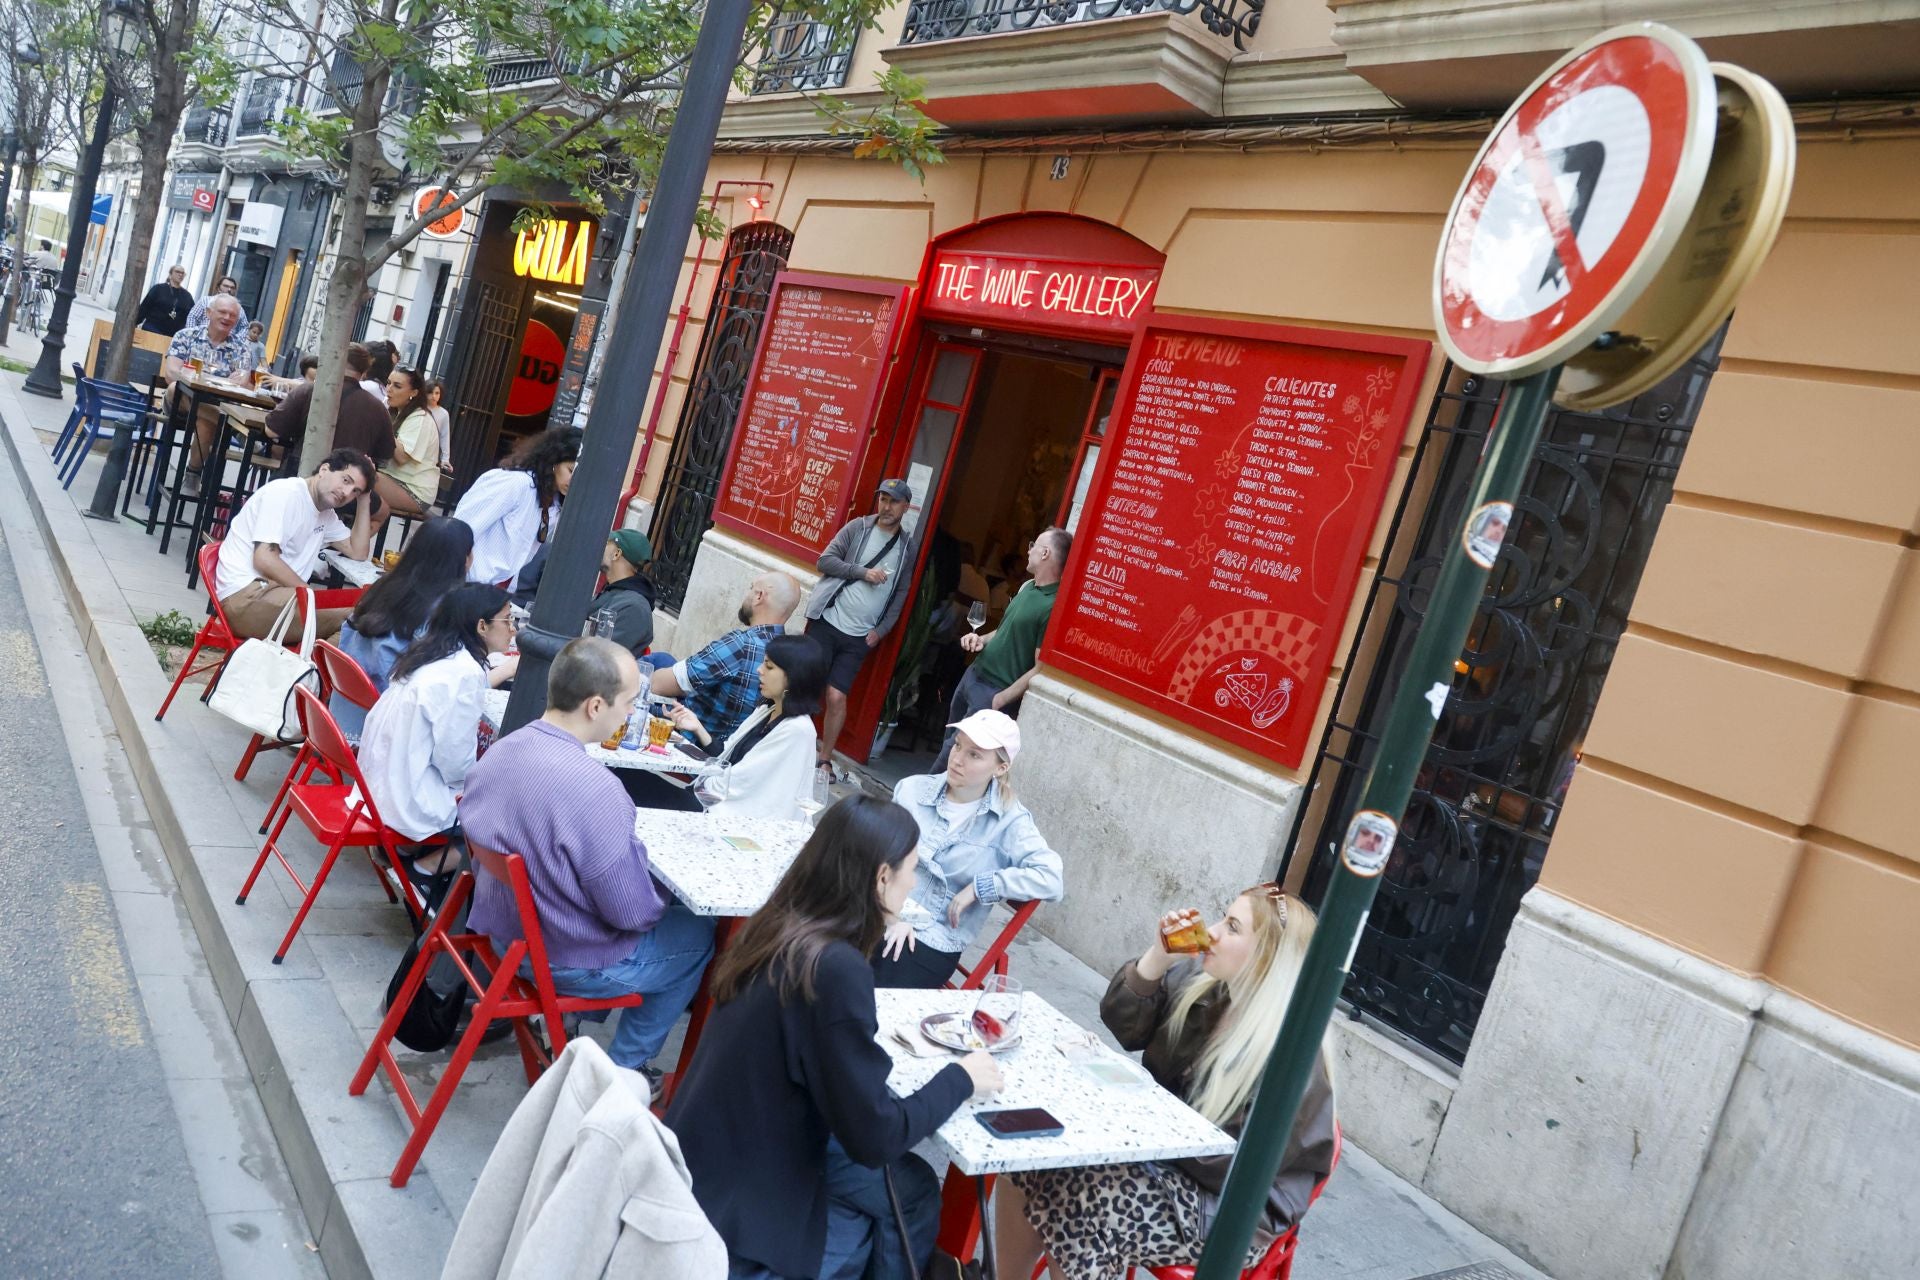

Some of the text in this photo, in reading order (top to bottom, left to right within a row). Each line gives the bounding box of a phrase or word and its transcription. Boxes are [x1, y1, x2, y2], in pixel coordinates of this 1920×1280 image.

[514, 218, 591, 286] GULA
[938, 263, 1154, 319] THE WINE GALLERY
[1155, 336, 1184, 359] THE
[1265, 376, 1336, 398] CALIENTES
[1263, 393, 1290, 405] PATATAS
[1179, 423, 1199, 434] QUESO
[1256, 416, 1286, 427] CROQUETA
[1179, 436, 1195, 445] QUESO
[1252, 427, 1283, 440] CROQUETA
[1249, 441, 1268, 453] TACOS
[1276, 446, 1297, 459] SETAS
[805, 458, 833, 475] EVERY
[1246, 453, 1272, 467] TORTILLA
[803, 472, 823, 486] WEEK
[1240, 466, 1261, 478] QUESO
[1269, 485, 1297, 496] CHICKEN
[1233, 491, 1292, 512] QUESO PROVOLONE
[790, 520, 819, 541] SEMANA
[1264, 529, 1295, 544] PATATAS
[1087, 560, 1126, 582] EN LATA
[1214, 548, 1301, 581] PARA ACABAR
[1208, 578, 1229, 591] POSTRE
